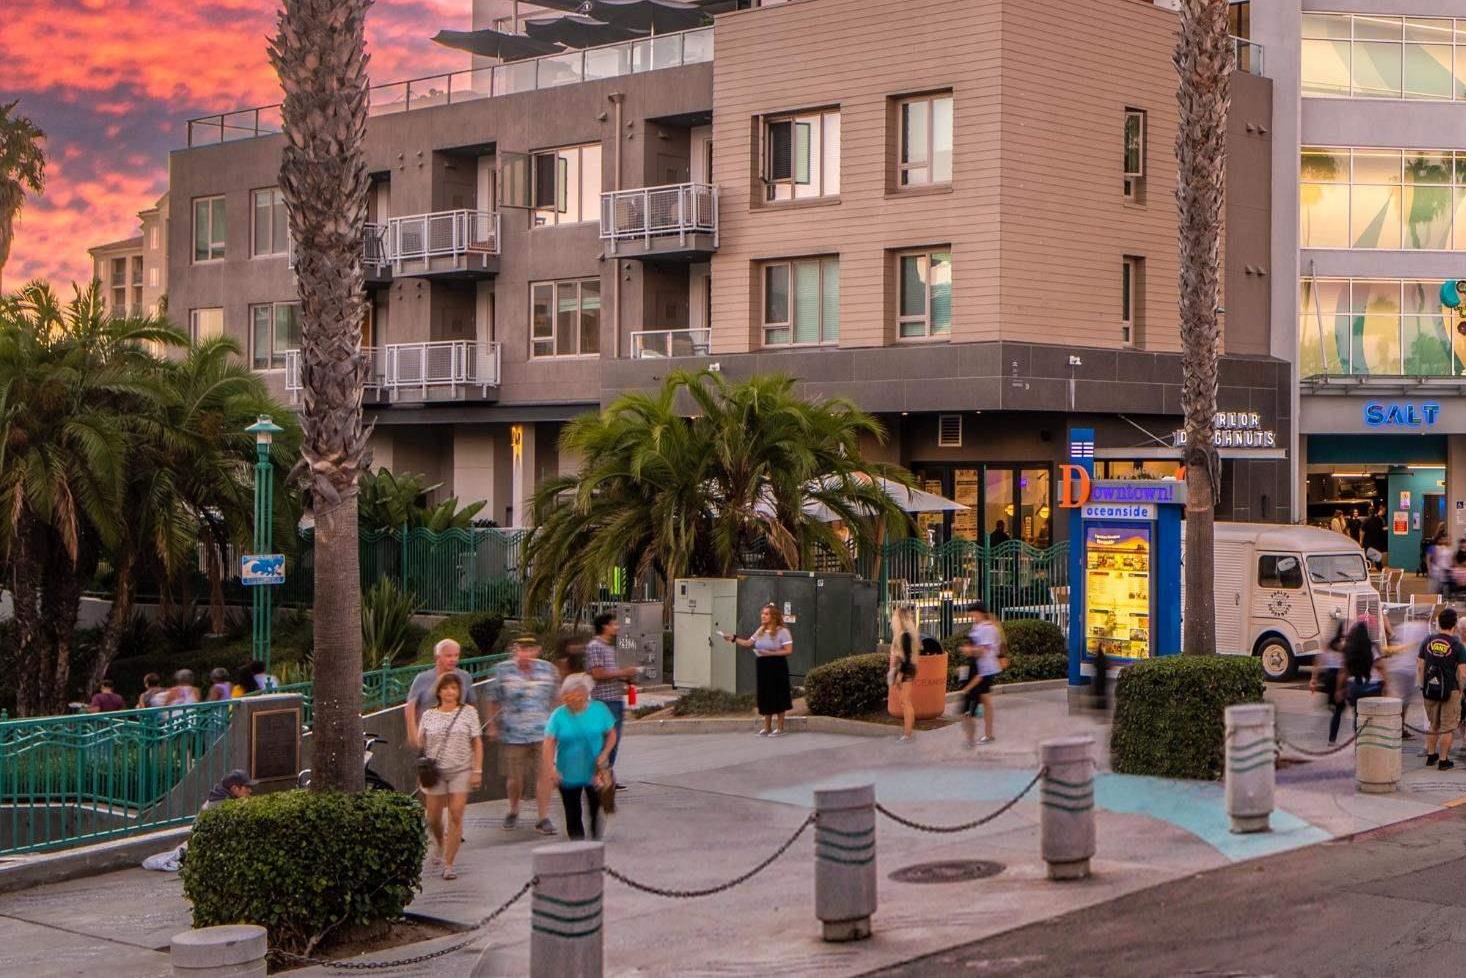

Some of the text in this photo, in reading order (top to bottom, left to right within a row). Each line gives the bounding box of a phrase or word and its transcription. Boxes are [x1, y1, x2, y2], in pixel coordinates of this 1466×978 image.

[1217, 413, 1260, 427] RLOR
[1366, 404, 1440, 424] SALT
[1178, 429, 1276, 446] DGHNUTS
[1086, 505, 1149, 518] oceanside
